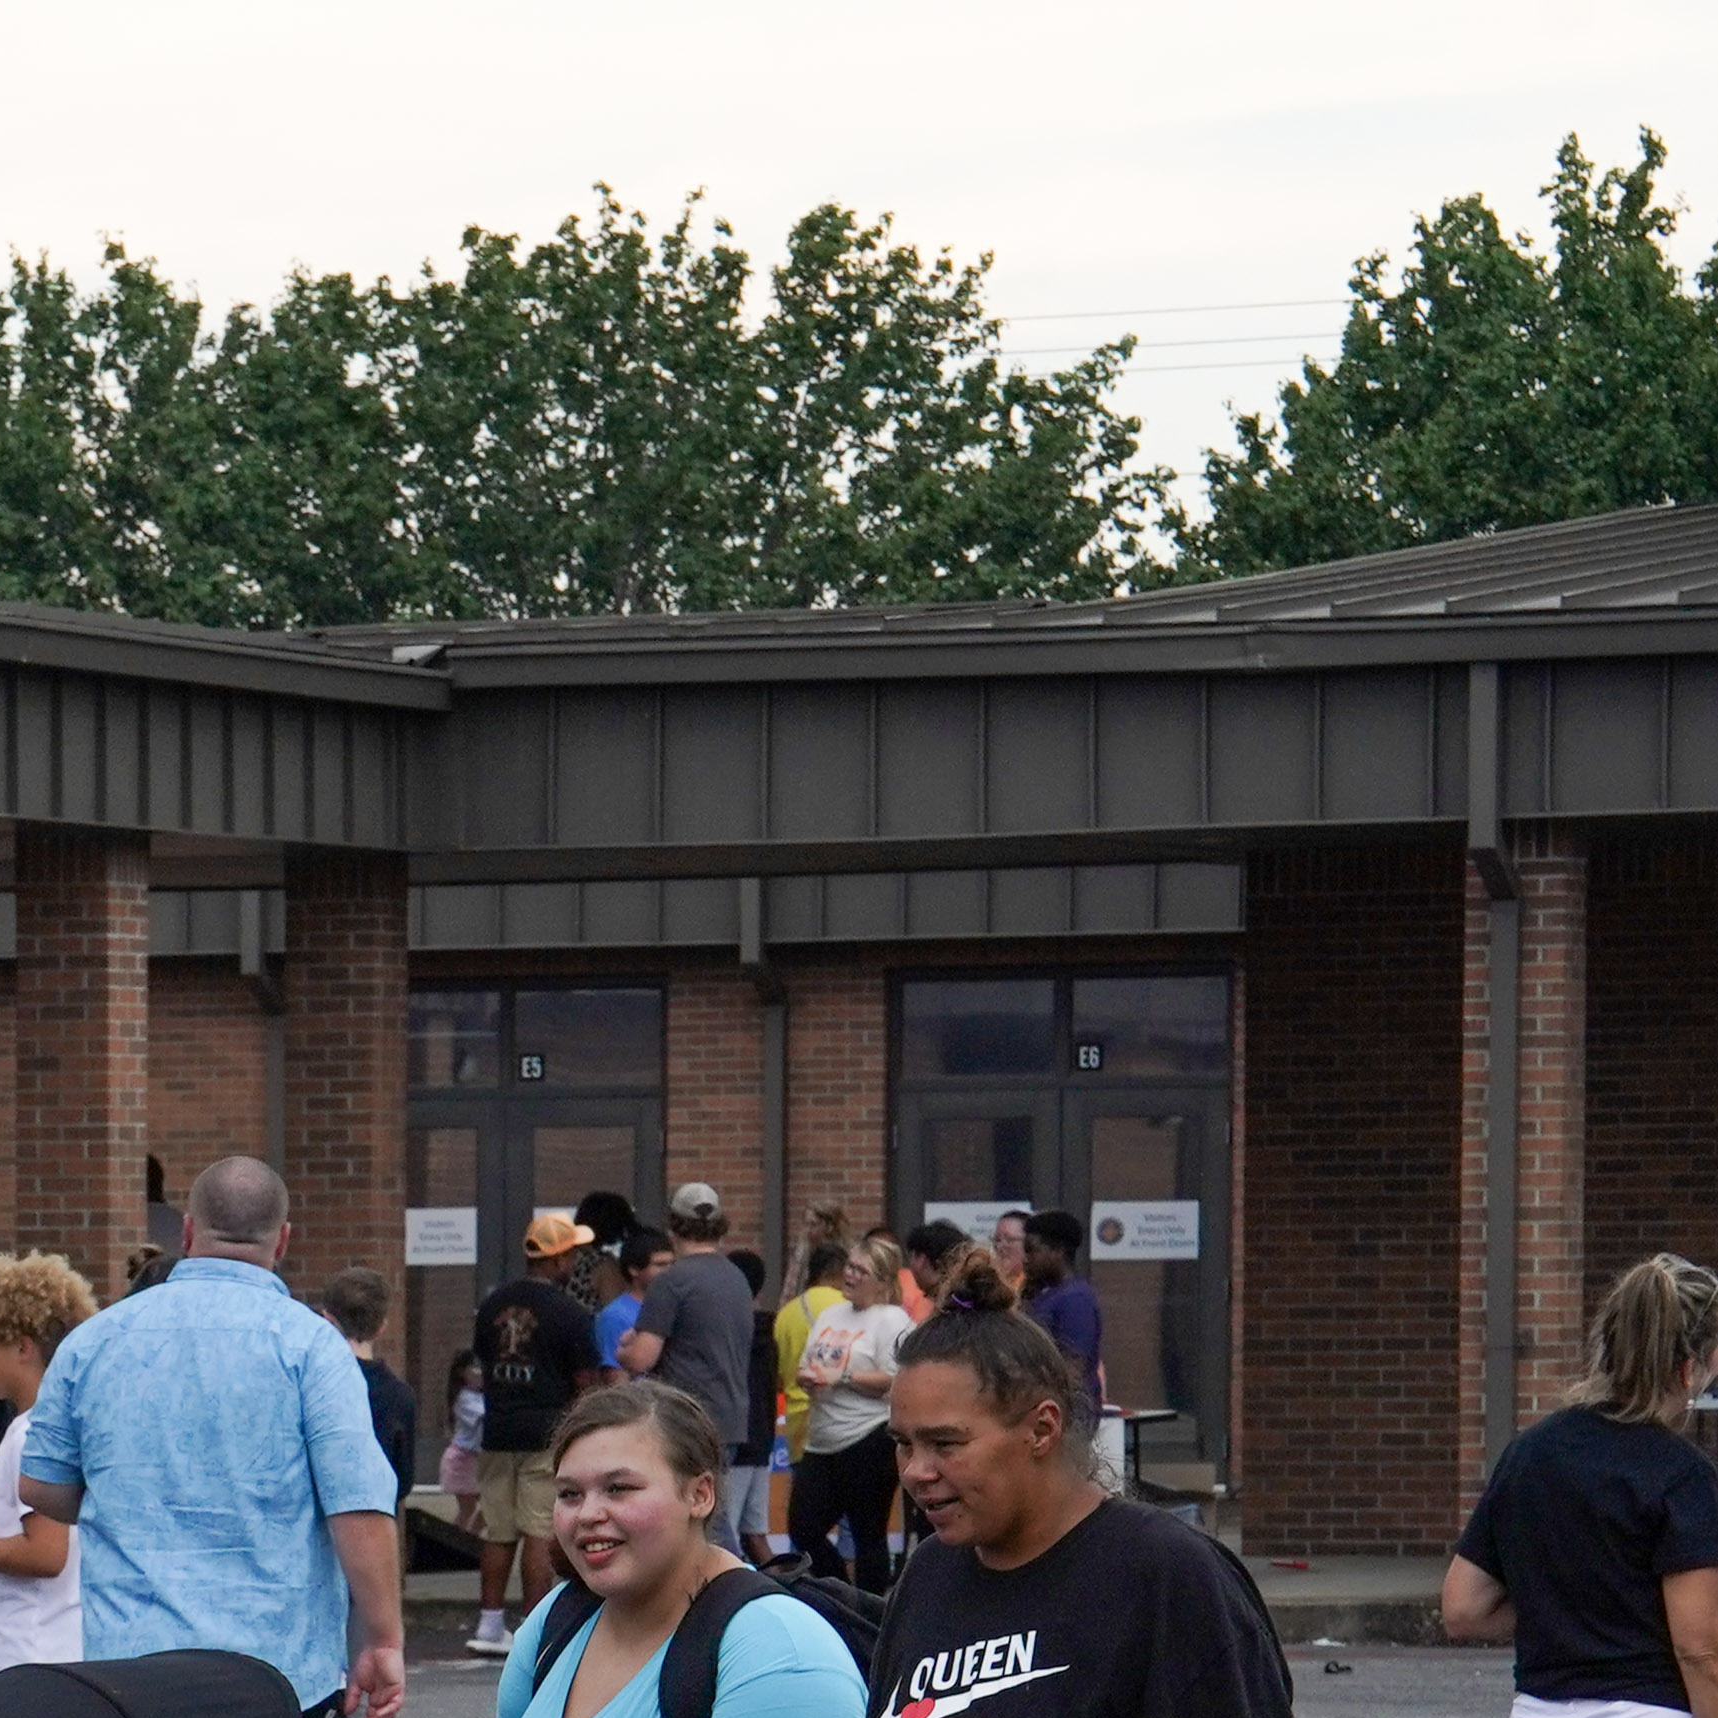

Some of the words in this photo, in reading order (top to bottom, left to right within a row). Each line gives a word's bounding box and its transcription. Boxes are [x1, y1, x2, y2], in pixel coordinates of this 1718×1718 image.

[521, 1055, 543, 1078] E5
[1078, 1045, 1101, 1069] E6
[909, 1629, 1038, 1703] QUEEN
